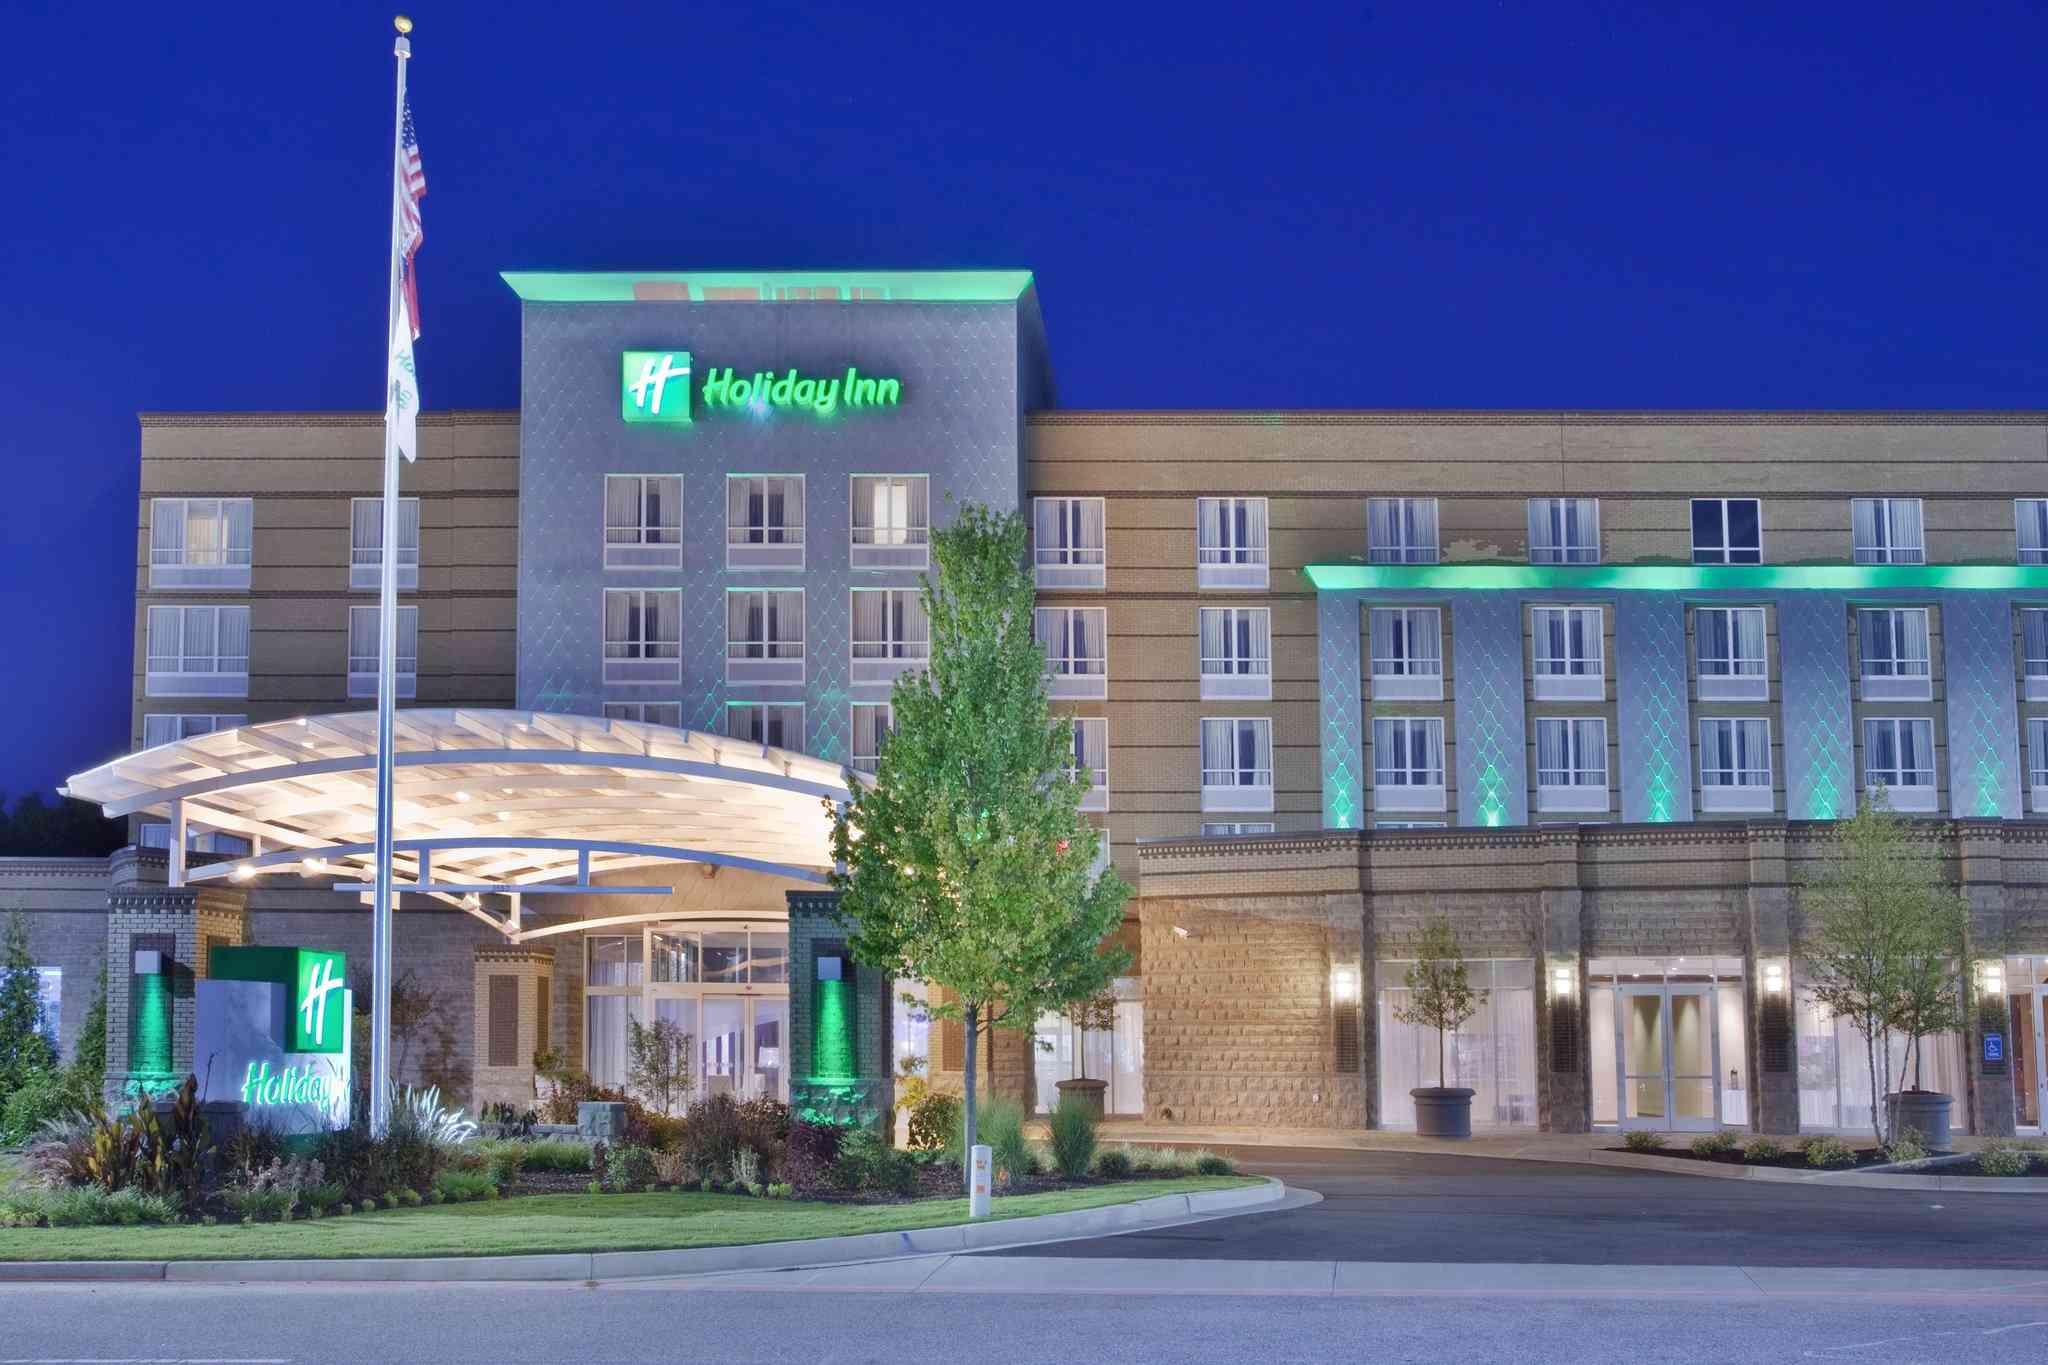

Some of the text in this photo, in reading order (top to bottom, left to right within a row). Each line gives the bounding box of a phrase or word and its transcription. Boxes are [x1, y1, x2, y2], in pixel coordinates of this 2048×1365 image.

[630, 355, 690, 414] H
[702, 367, 900, 411] Holiday Inn
[300, 959, 343, 1045] H
